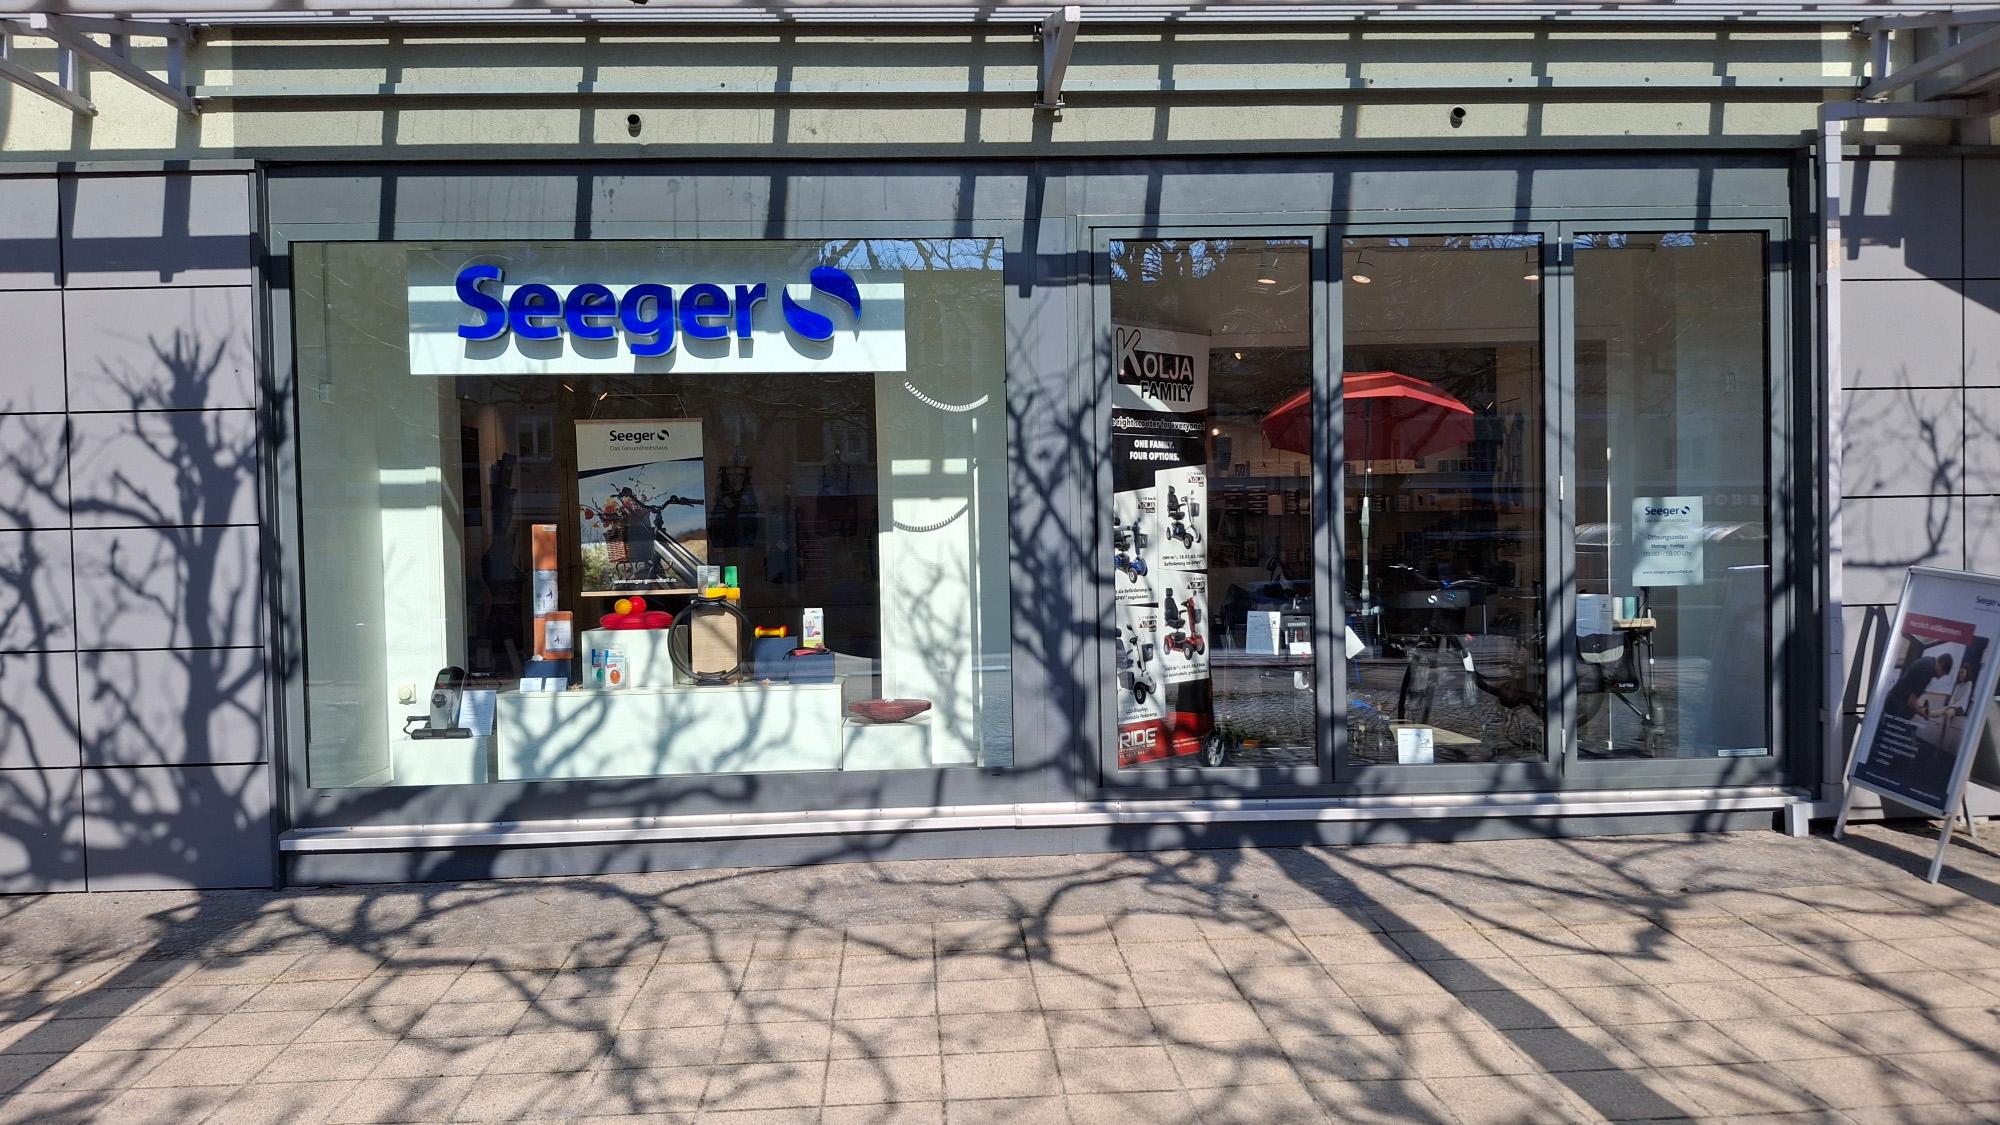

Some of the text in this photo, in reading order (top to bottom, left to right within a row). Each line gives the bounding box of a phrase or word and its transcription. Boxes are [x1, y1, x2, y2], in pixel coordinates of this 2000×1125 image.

[456, 264, 768, 358] Seeger
[1116, 327, 1193, 381] KOLJA
[1140, 380, 1194, 402] FAMILY
[1134, 418, 1160, 429] scooter
[1160, 419, 1170, 429] for
[609, 430, 656, 443] Seeger
[1134, 439, 1175, 449] ONE FAMILY.
[1129, 451, 1180, 461] FOUR OPTIONS.
[1644, 506, 1680, 517] Seeger
[1119, 727, 1158, 749] RIDE
